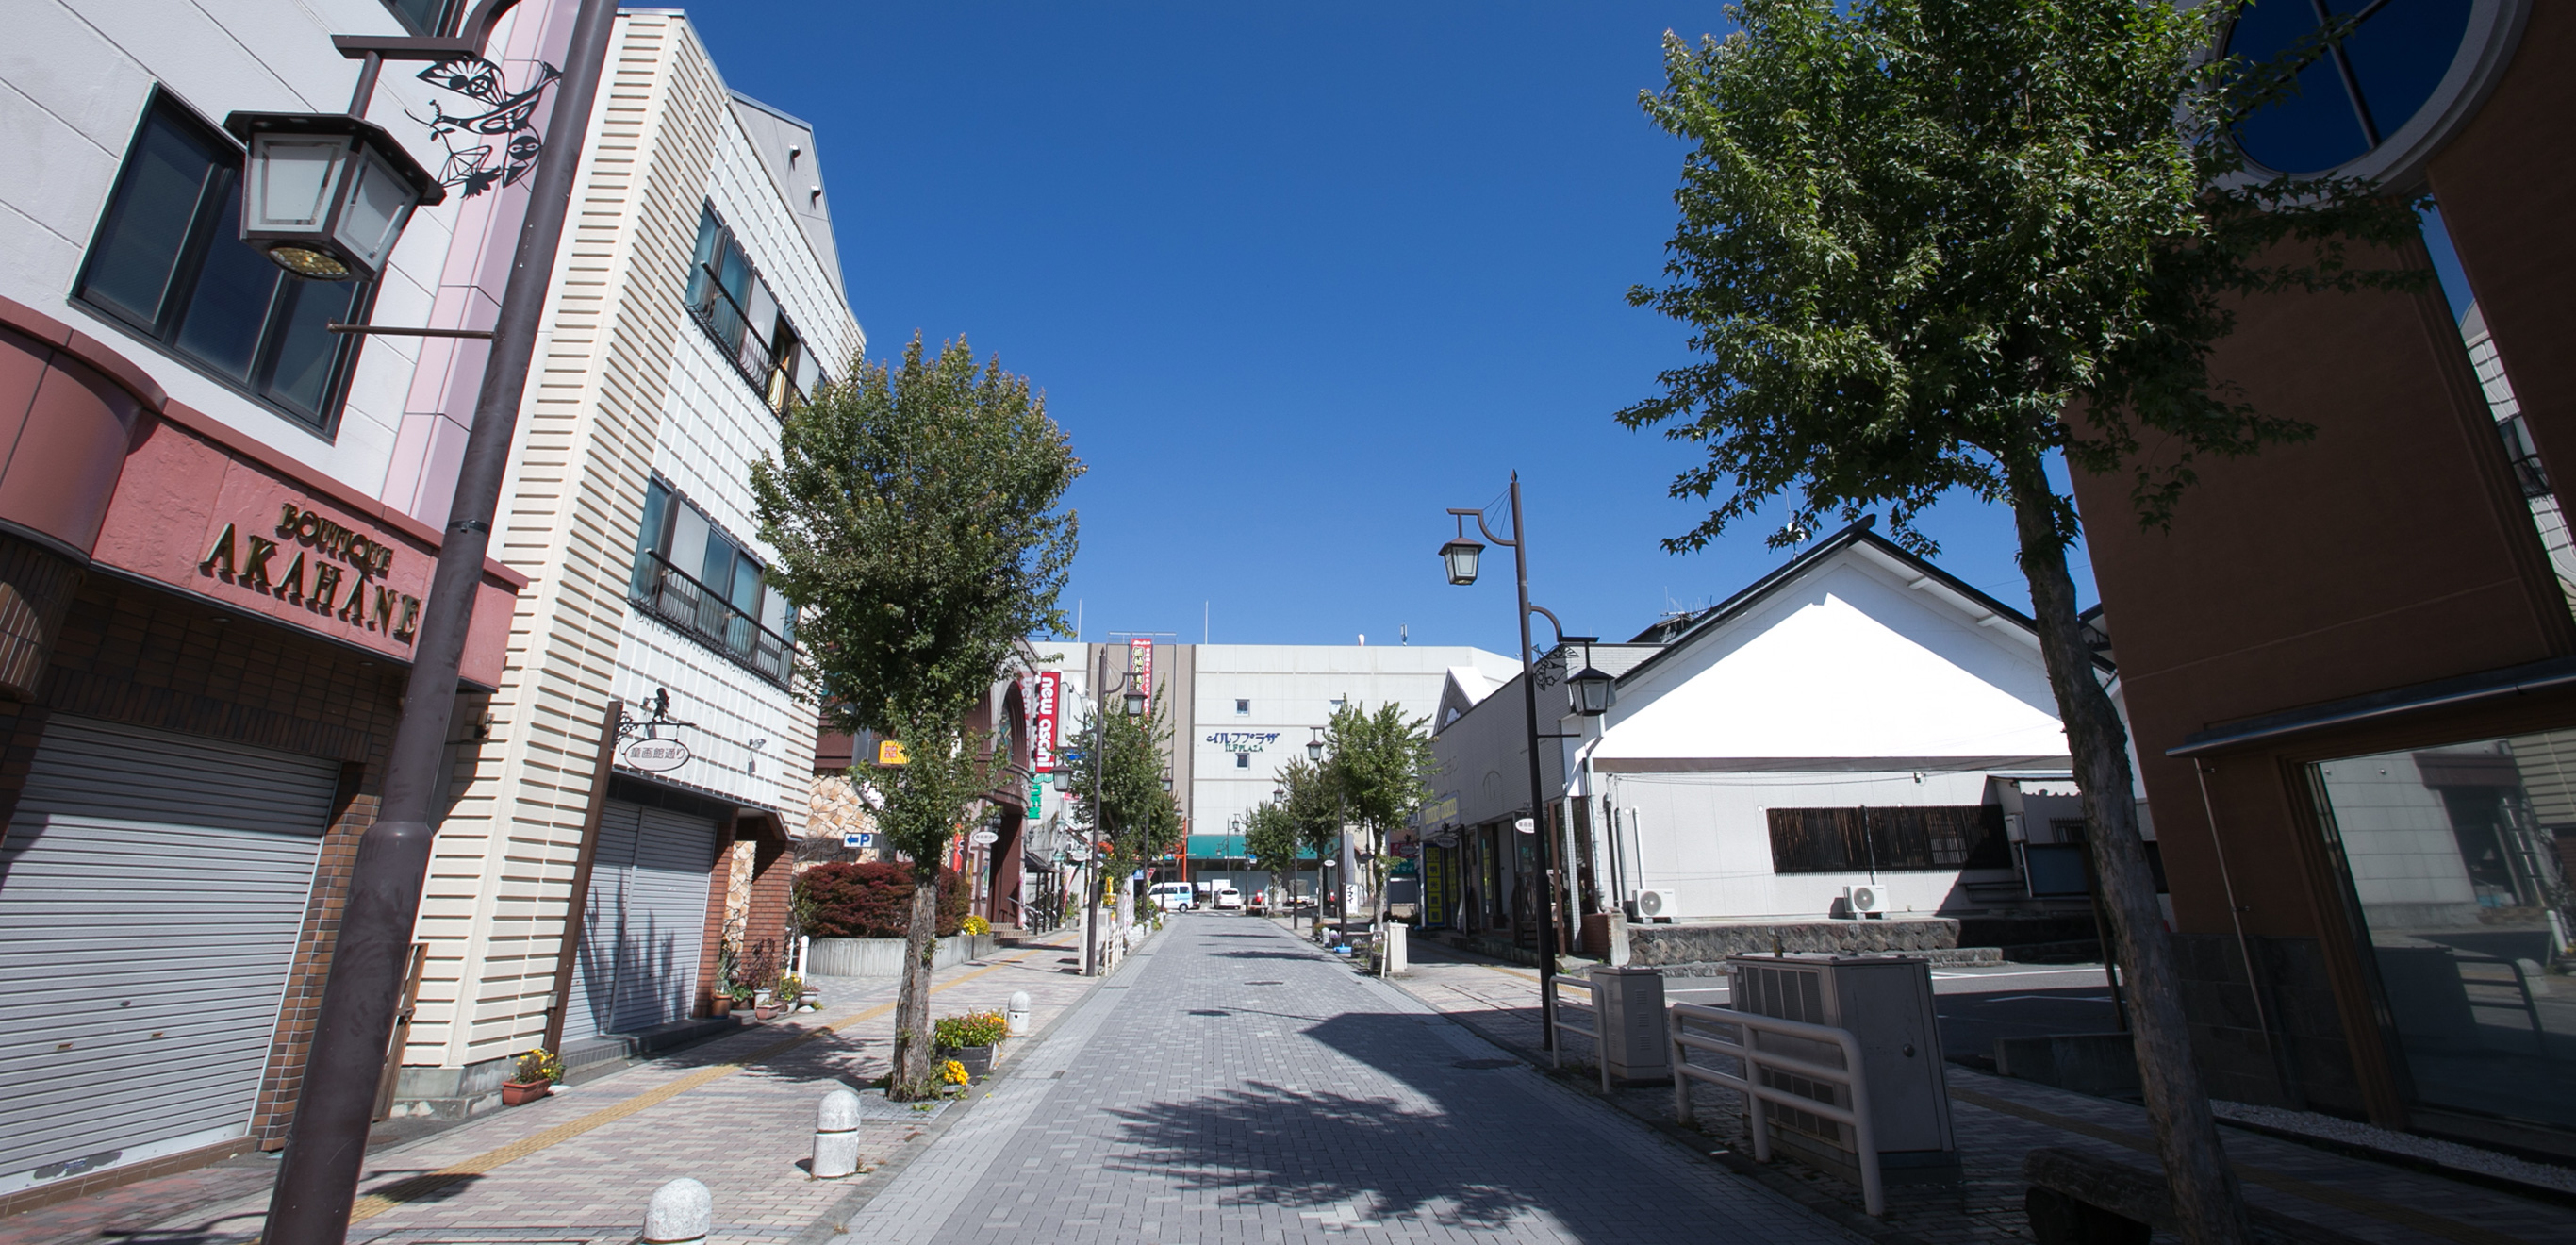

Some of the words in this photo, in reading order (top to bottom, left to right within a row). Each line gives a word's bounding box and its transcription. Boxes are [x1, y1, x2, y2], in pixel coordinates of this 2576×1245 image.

[275, 502, 394, 573] BOUTIQUE
[199, 523, 421, 639] AKAHANE
[1040, 676, 1054, 715] new
[1037, 718, 1054, 768] asahi
[1206, 732, 1280, 744] イルフプラザ
[1225, 742, 1238, 752] ILF
[1238, 743, 1263, 752] PLAZA
[630, 747, 685, 760] 童画館通り
[860, 834, 870, 846] P
